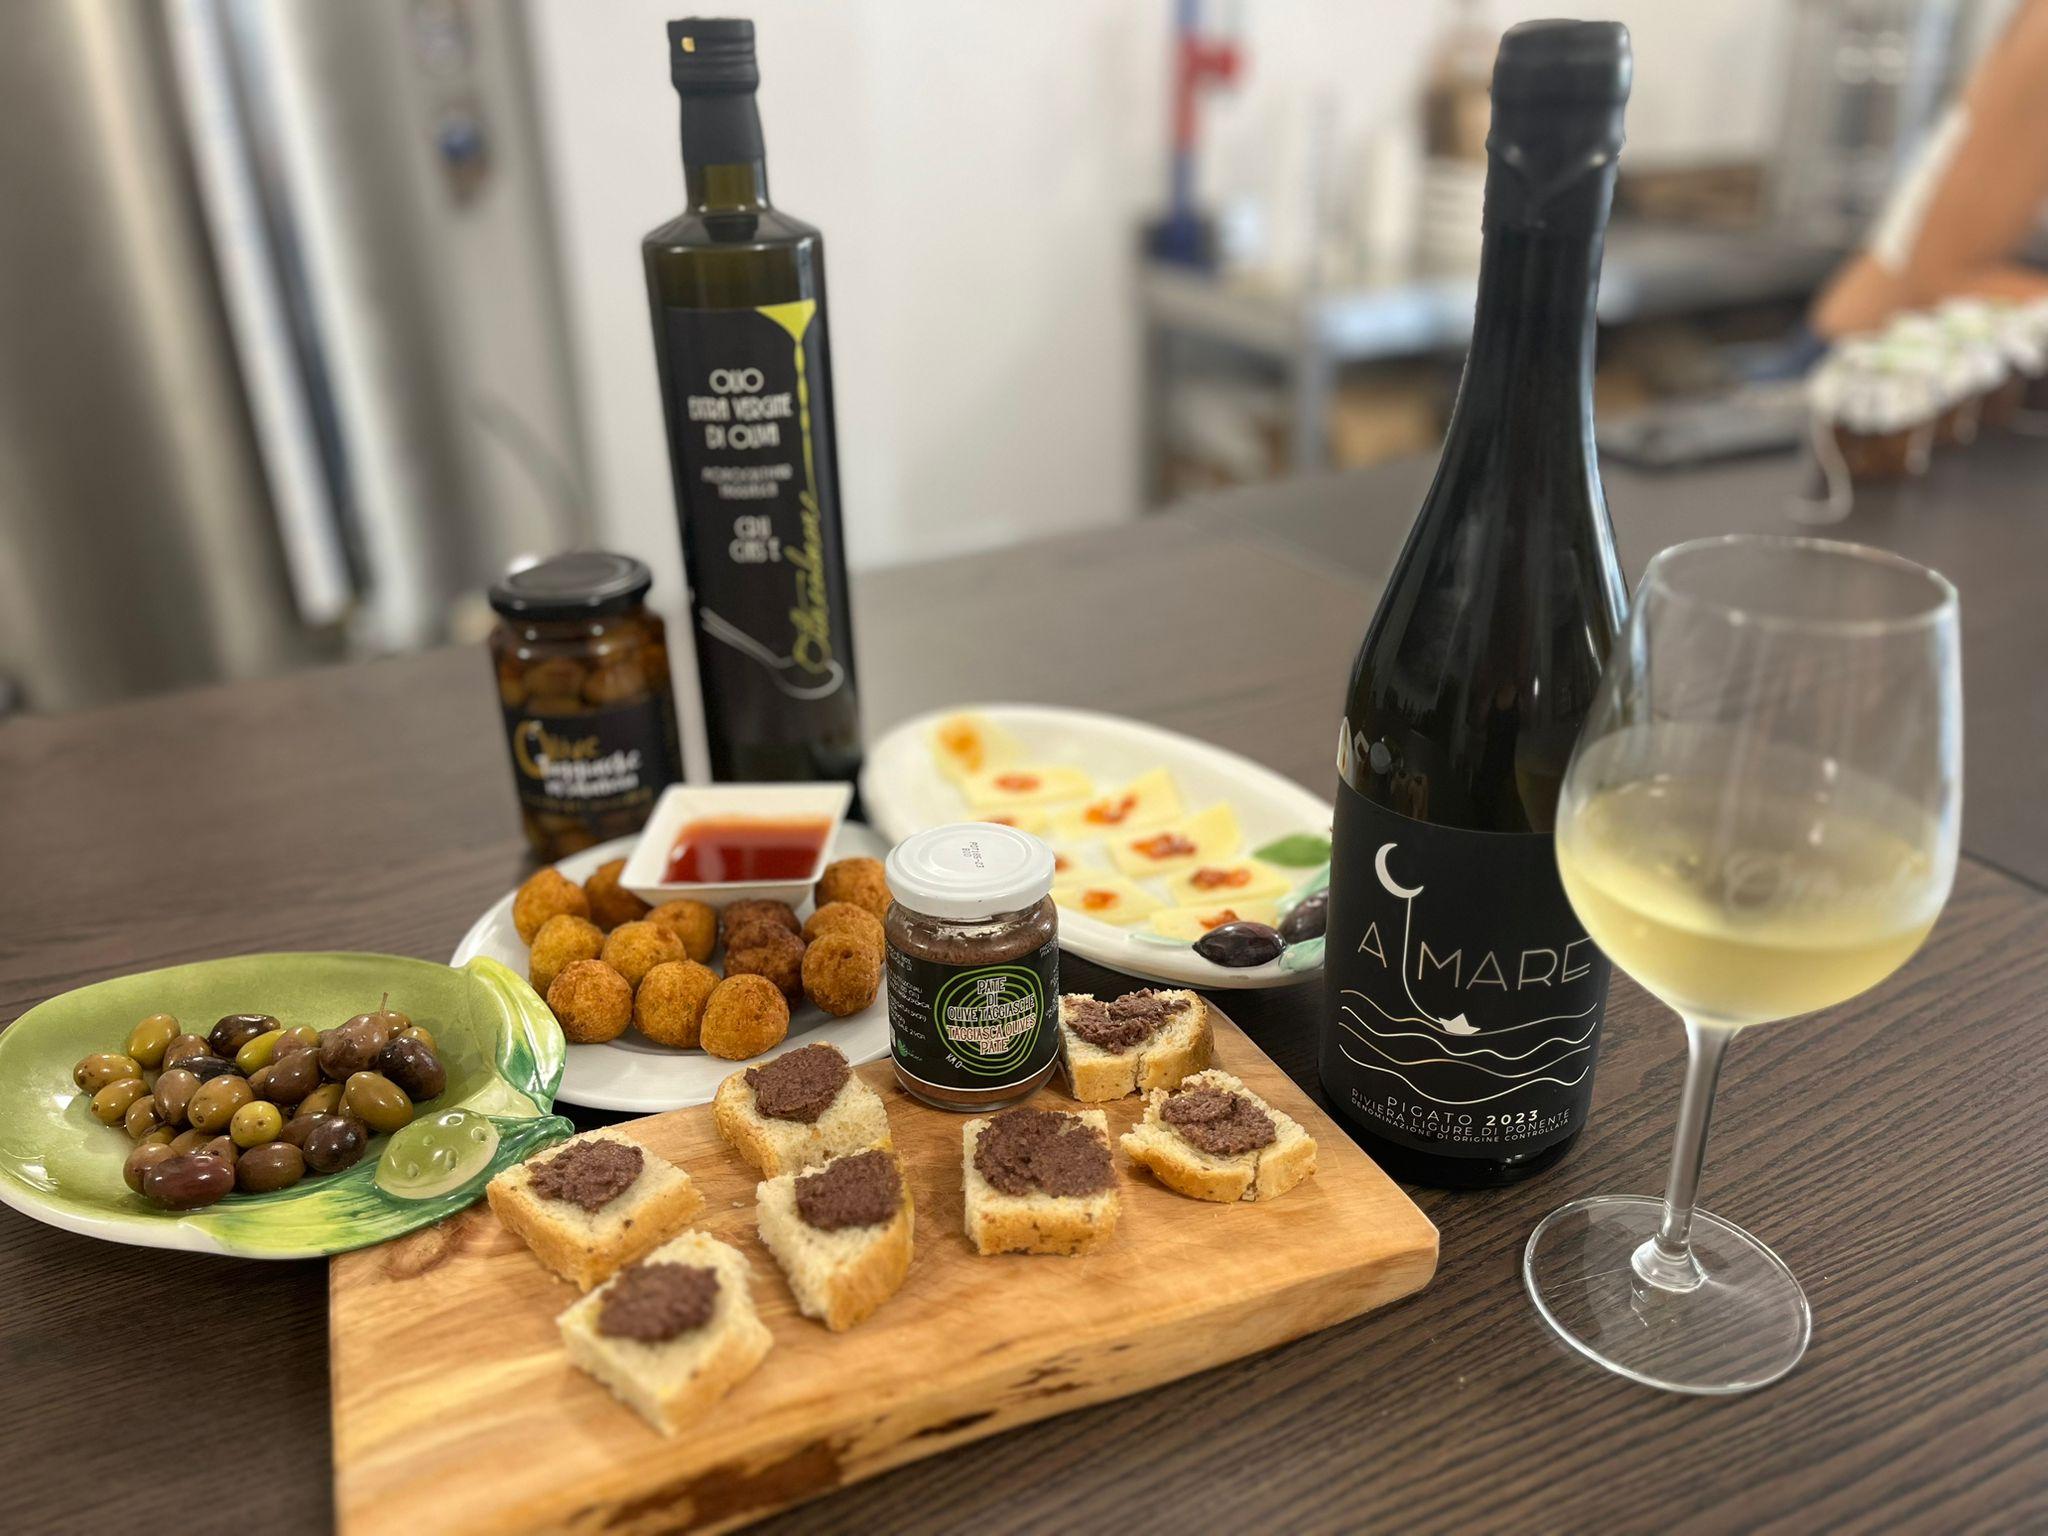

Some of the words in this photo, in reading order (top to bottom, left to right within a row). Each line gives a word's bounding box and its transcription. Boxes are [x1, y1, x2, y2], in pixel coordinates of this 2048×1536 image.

[947, 1005, 978, 1022] OLIVE
[978, 993, 1036, 1021] TAGGIASCHE
[986, 992, 999, 1006] DI
[947, 1024, 1005, 1042] TAGGIASCA
[1004, 1012, 1037, 1036] OLIVES
[1351, 1087, 1405, 1122] RIVIERA
[1412, 1117, 1473, 1136] LIGURE
[1481, 1127, 1498, 1136] DI
[1505, 1107, 1570, 1134] PONENTE
[1351, 1097, 1431, 1137] DENOMINAZIONE
[1437, 1132, 1449, 1140] DI
[1453, 1135, 1500, 1143] ORIGINE
[1504, 1118, 1569, 1142] CONTROLLATA
[1387, 1096, 1473, 1126] PIGATO
[1486, 1109, 1539, 1126] 2023
